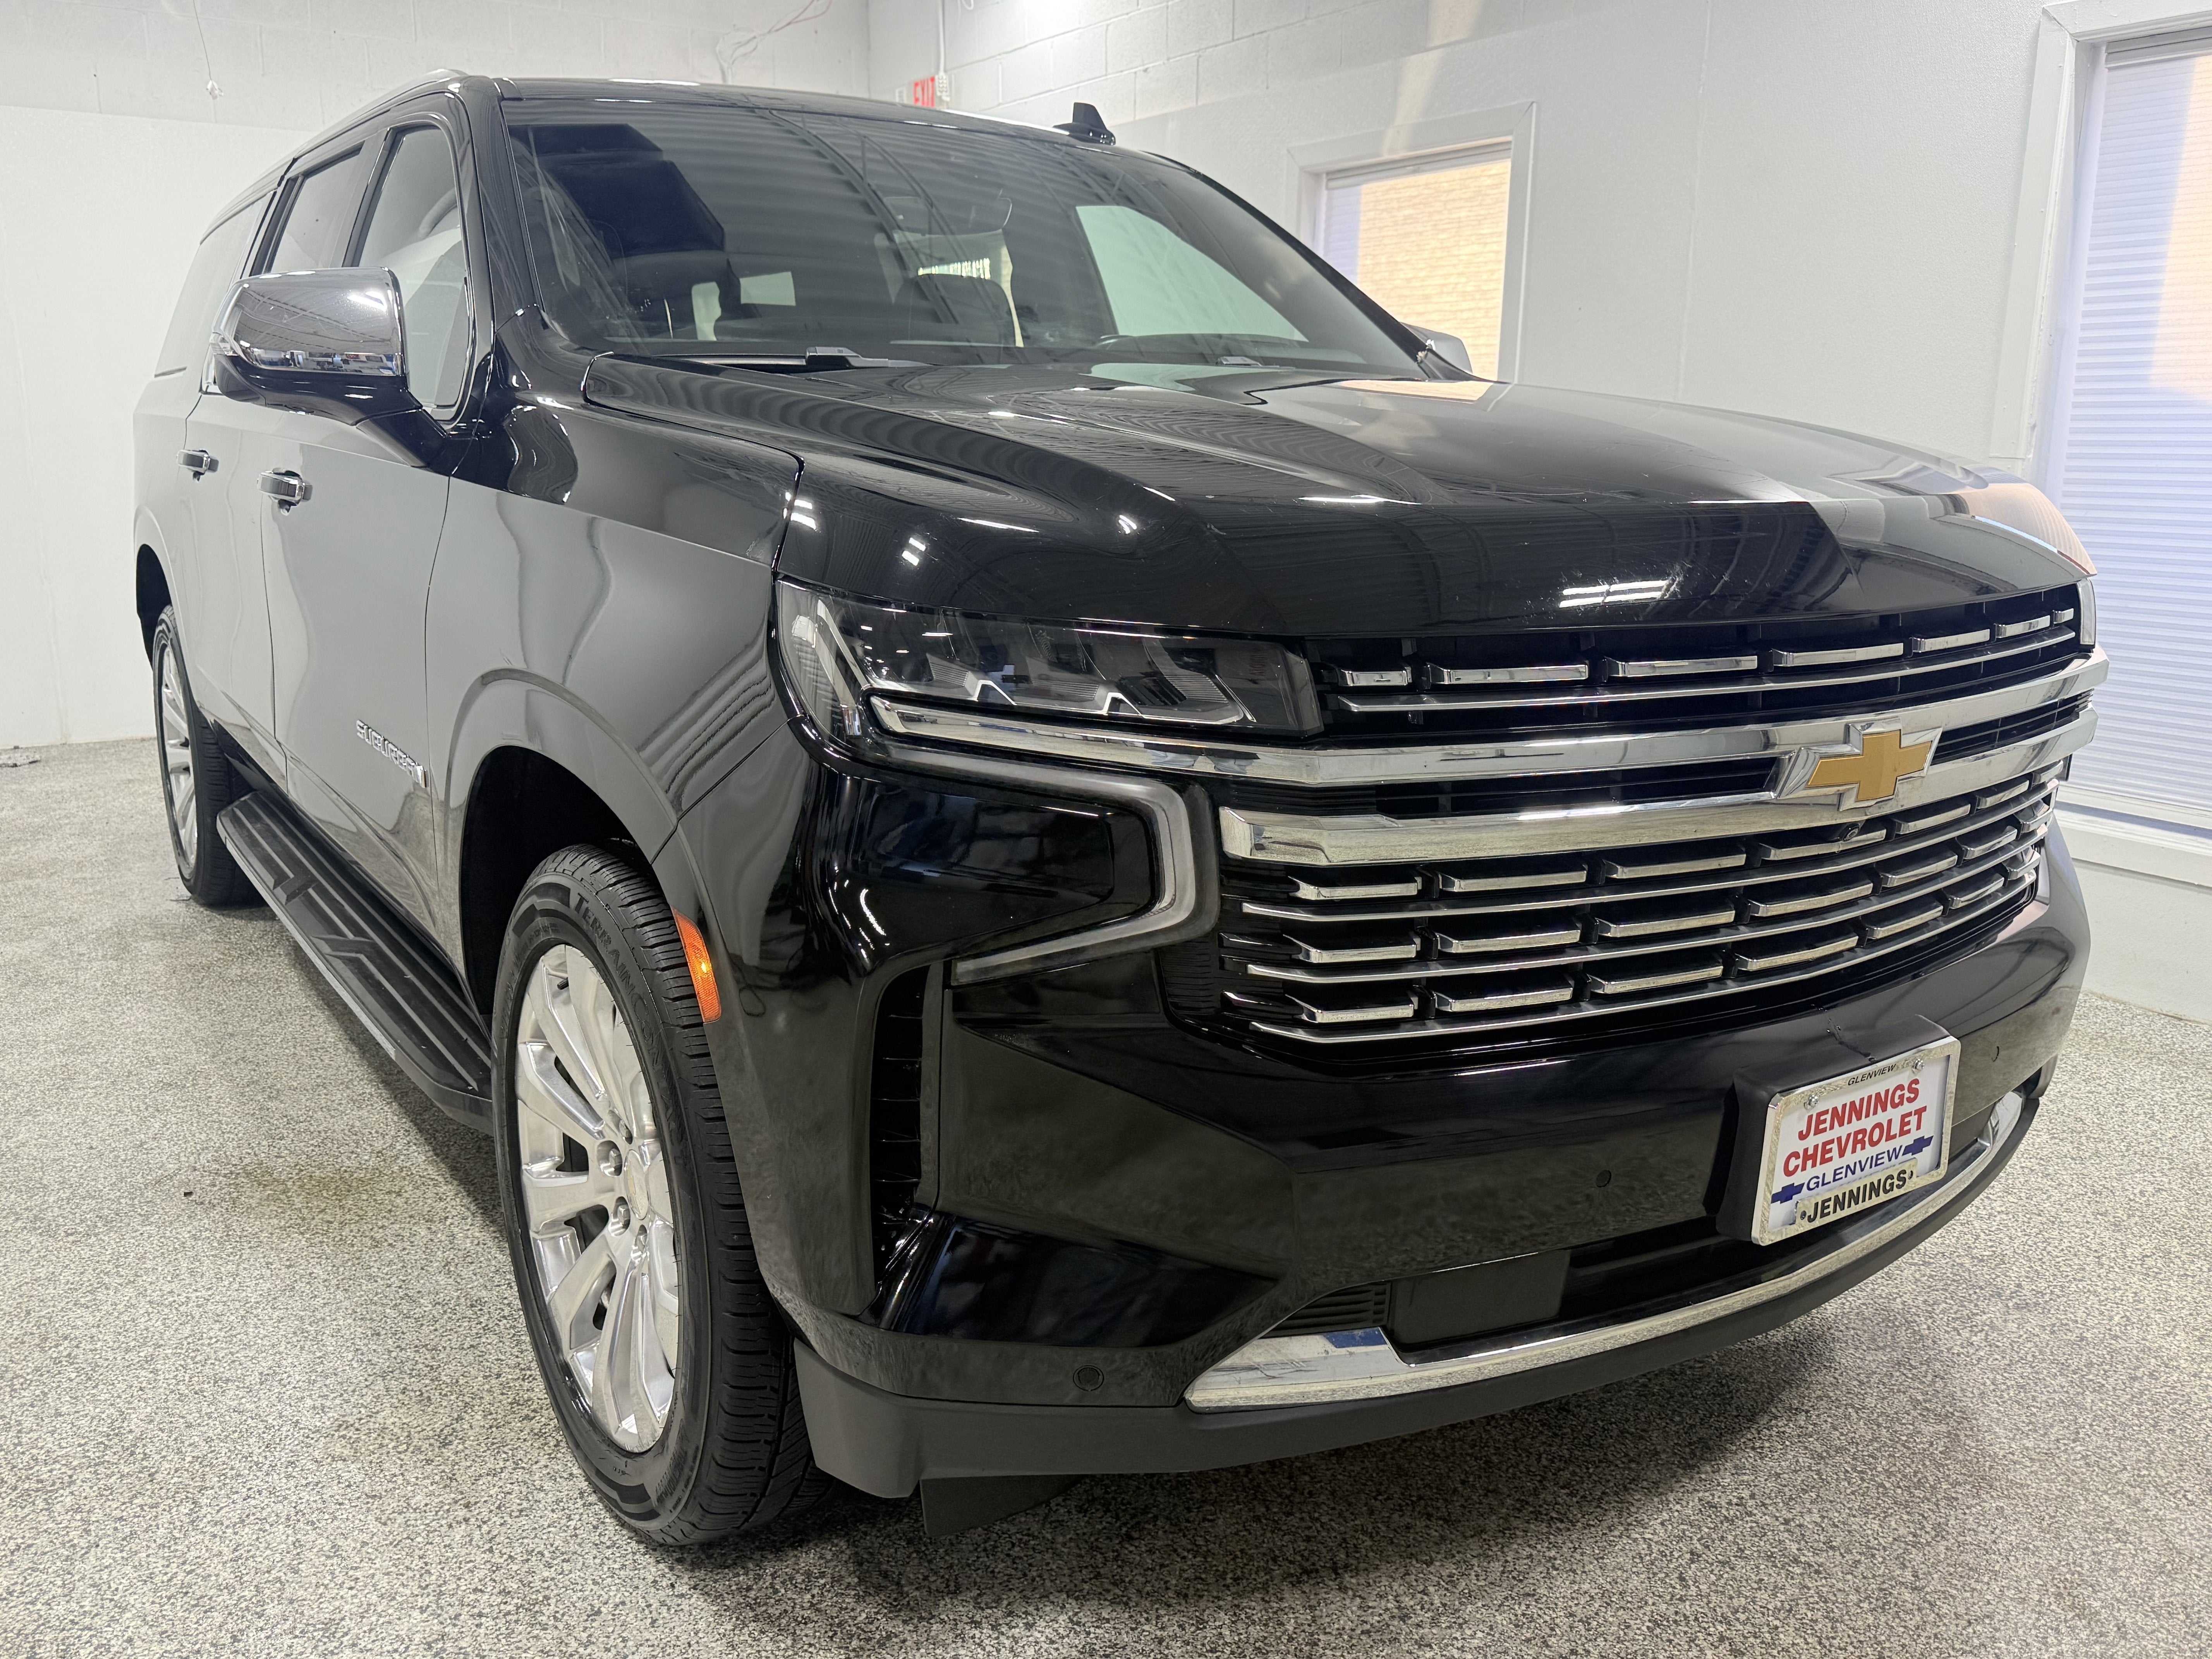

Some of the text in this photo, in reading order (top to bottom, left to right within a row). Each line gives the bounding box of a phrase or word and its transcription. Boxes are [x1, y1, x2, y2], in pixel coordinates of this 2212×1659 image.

[1848, 1063, 1896, 1086] GLENVIEW
[1798, 1079, 1920, 1141] JENNINGS
[1783, 1106, 1927, 1177] CHEVROLET
[1806, 1145, 1903, 1191] GLENVIEW
[1807, 1169, 1906, 1223] JENNINGS
